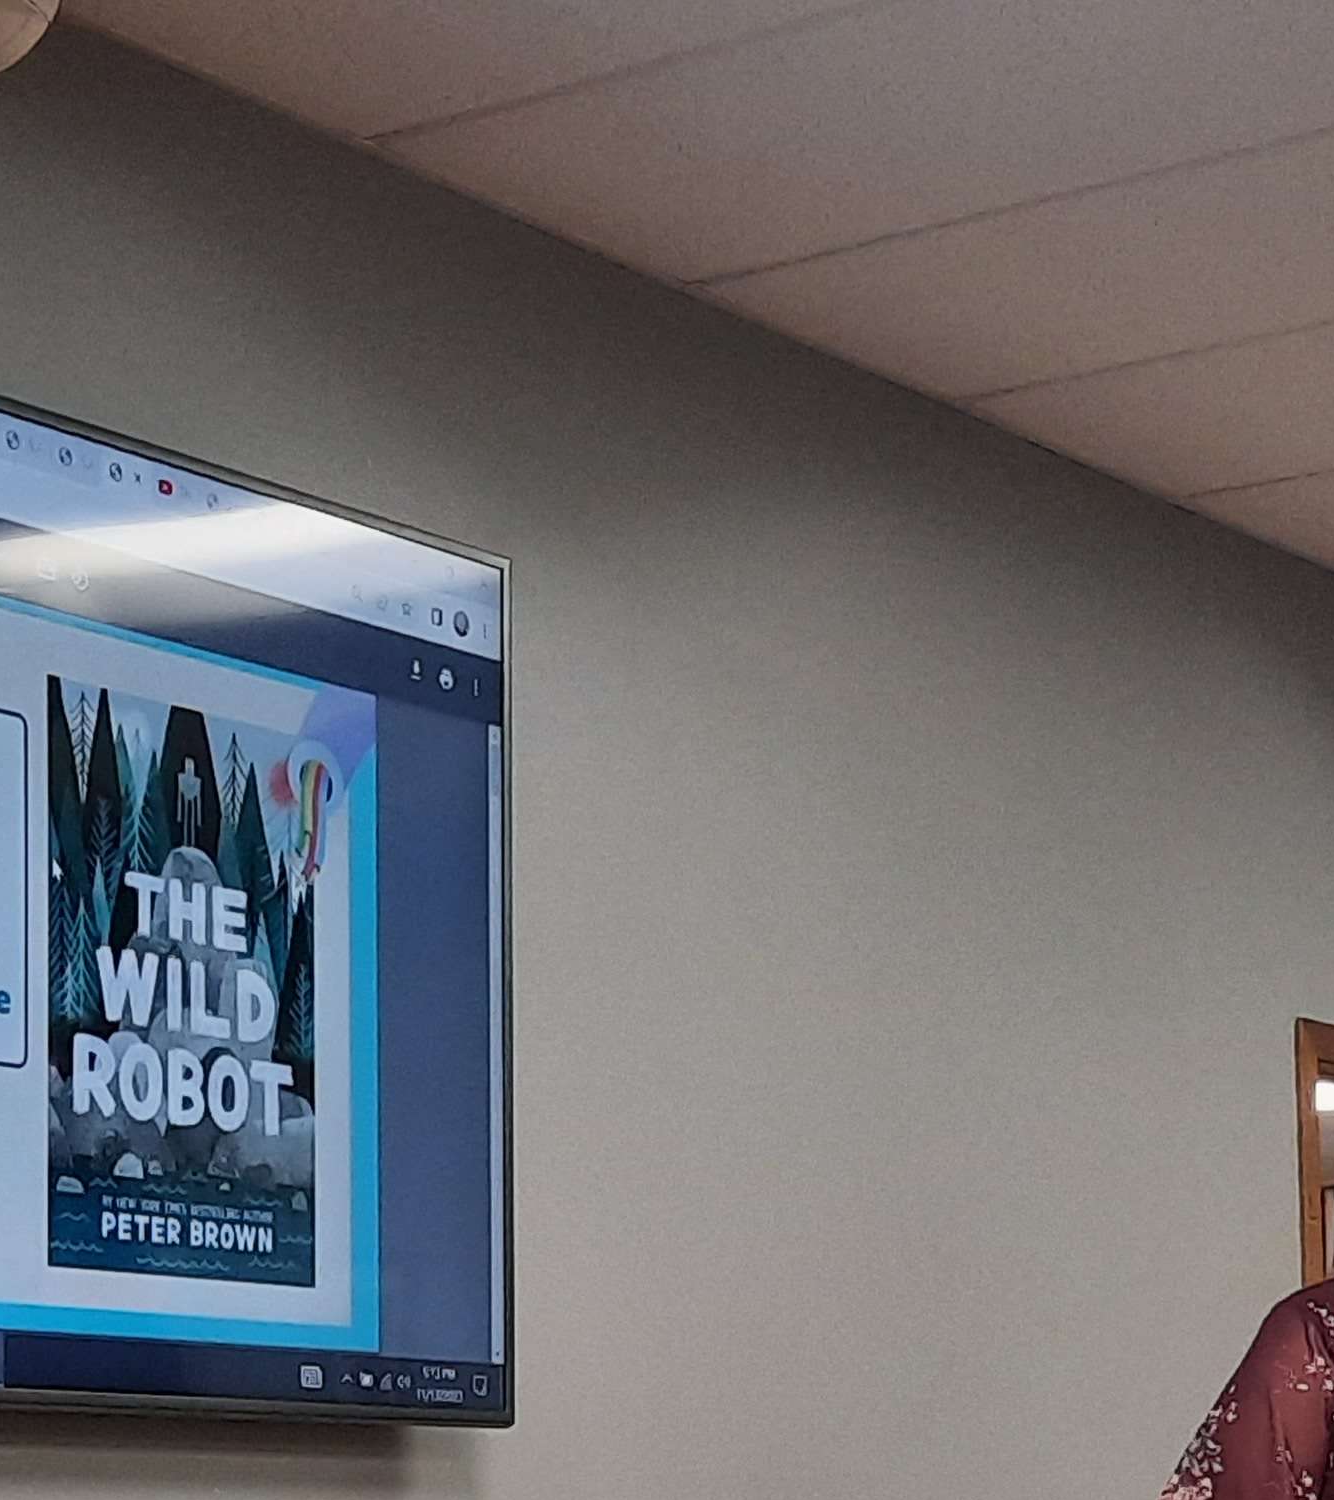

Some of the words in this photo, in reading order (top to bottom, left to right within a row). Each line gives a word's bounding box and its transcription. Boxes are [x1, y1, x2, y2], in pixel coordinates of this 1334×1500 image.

[124, 869, 250, 954] THE
[96, 944, 277, 1044] WILD
[71, 1031, 294, 1138] ROBOT
[101, 1211, 182, 1246] PETER
[189, 1218, 274, 1254] BROWN
